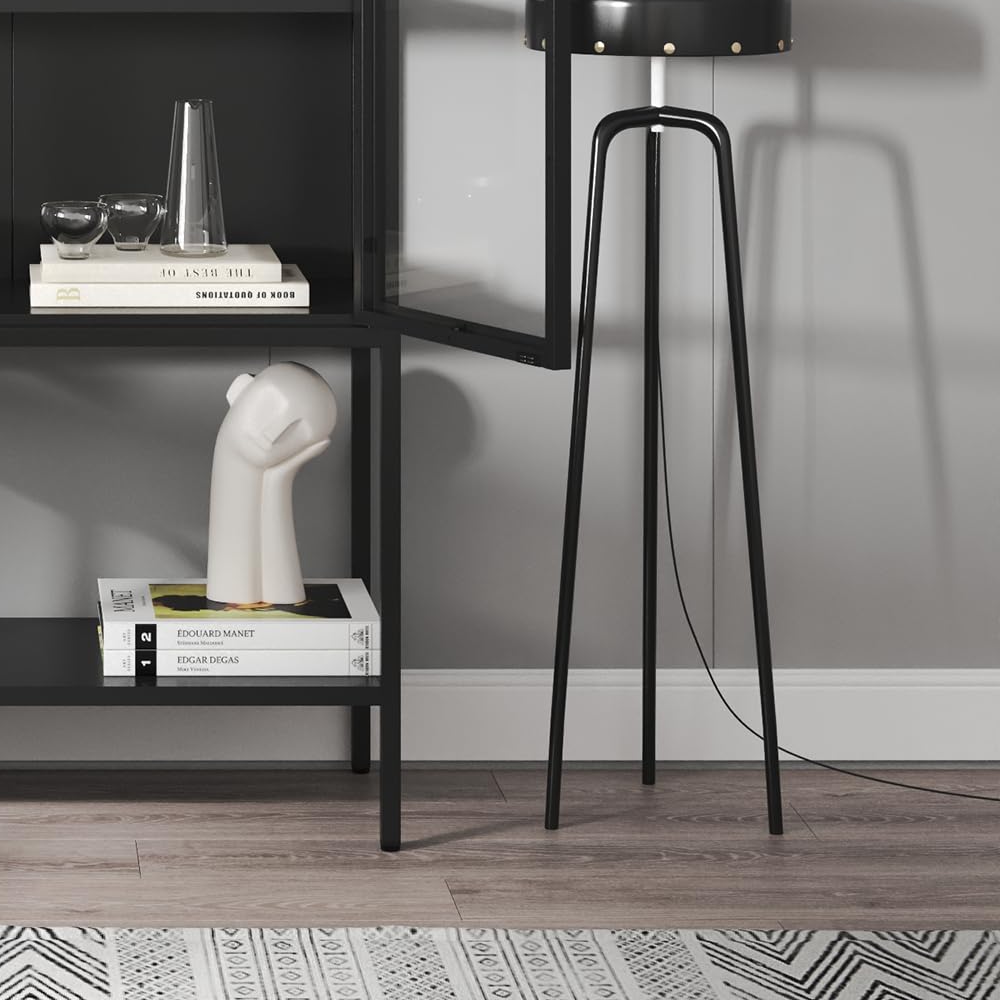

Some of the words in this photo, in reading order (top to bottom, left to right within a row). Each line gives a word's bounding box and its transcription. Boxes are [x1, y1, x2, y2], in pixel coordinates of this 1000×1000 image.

[184, 269, 217, 277] BEST
[226, 269, 252, 277] THE
[111, 589, 135, 612] MANET
[177, 629, 221, 637] ÉDOUARD
[141, 633, 152, 642] 2
[177, 656, 207, 664] EDGAR
[210, 656, 239, 664] DEGAS
